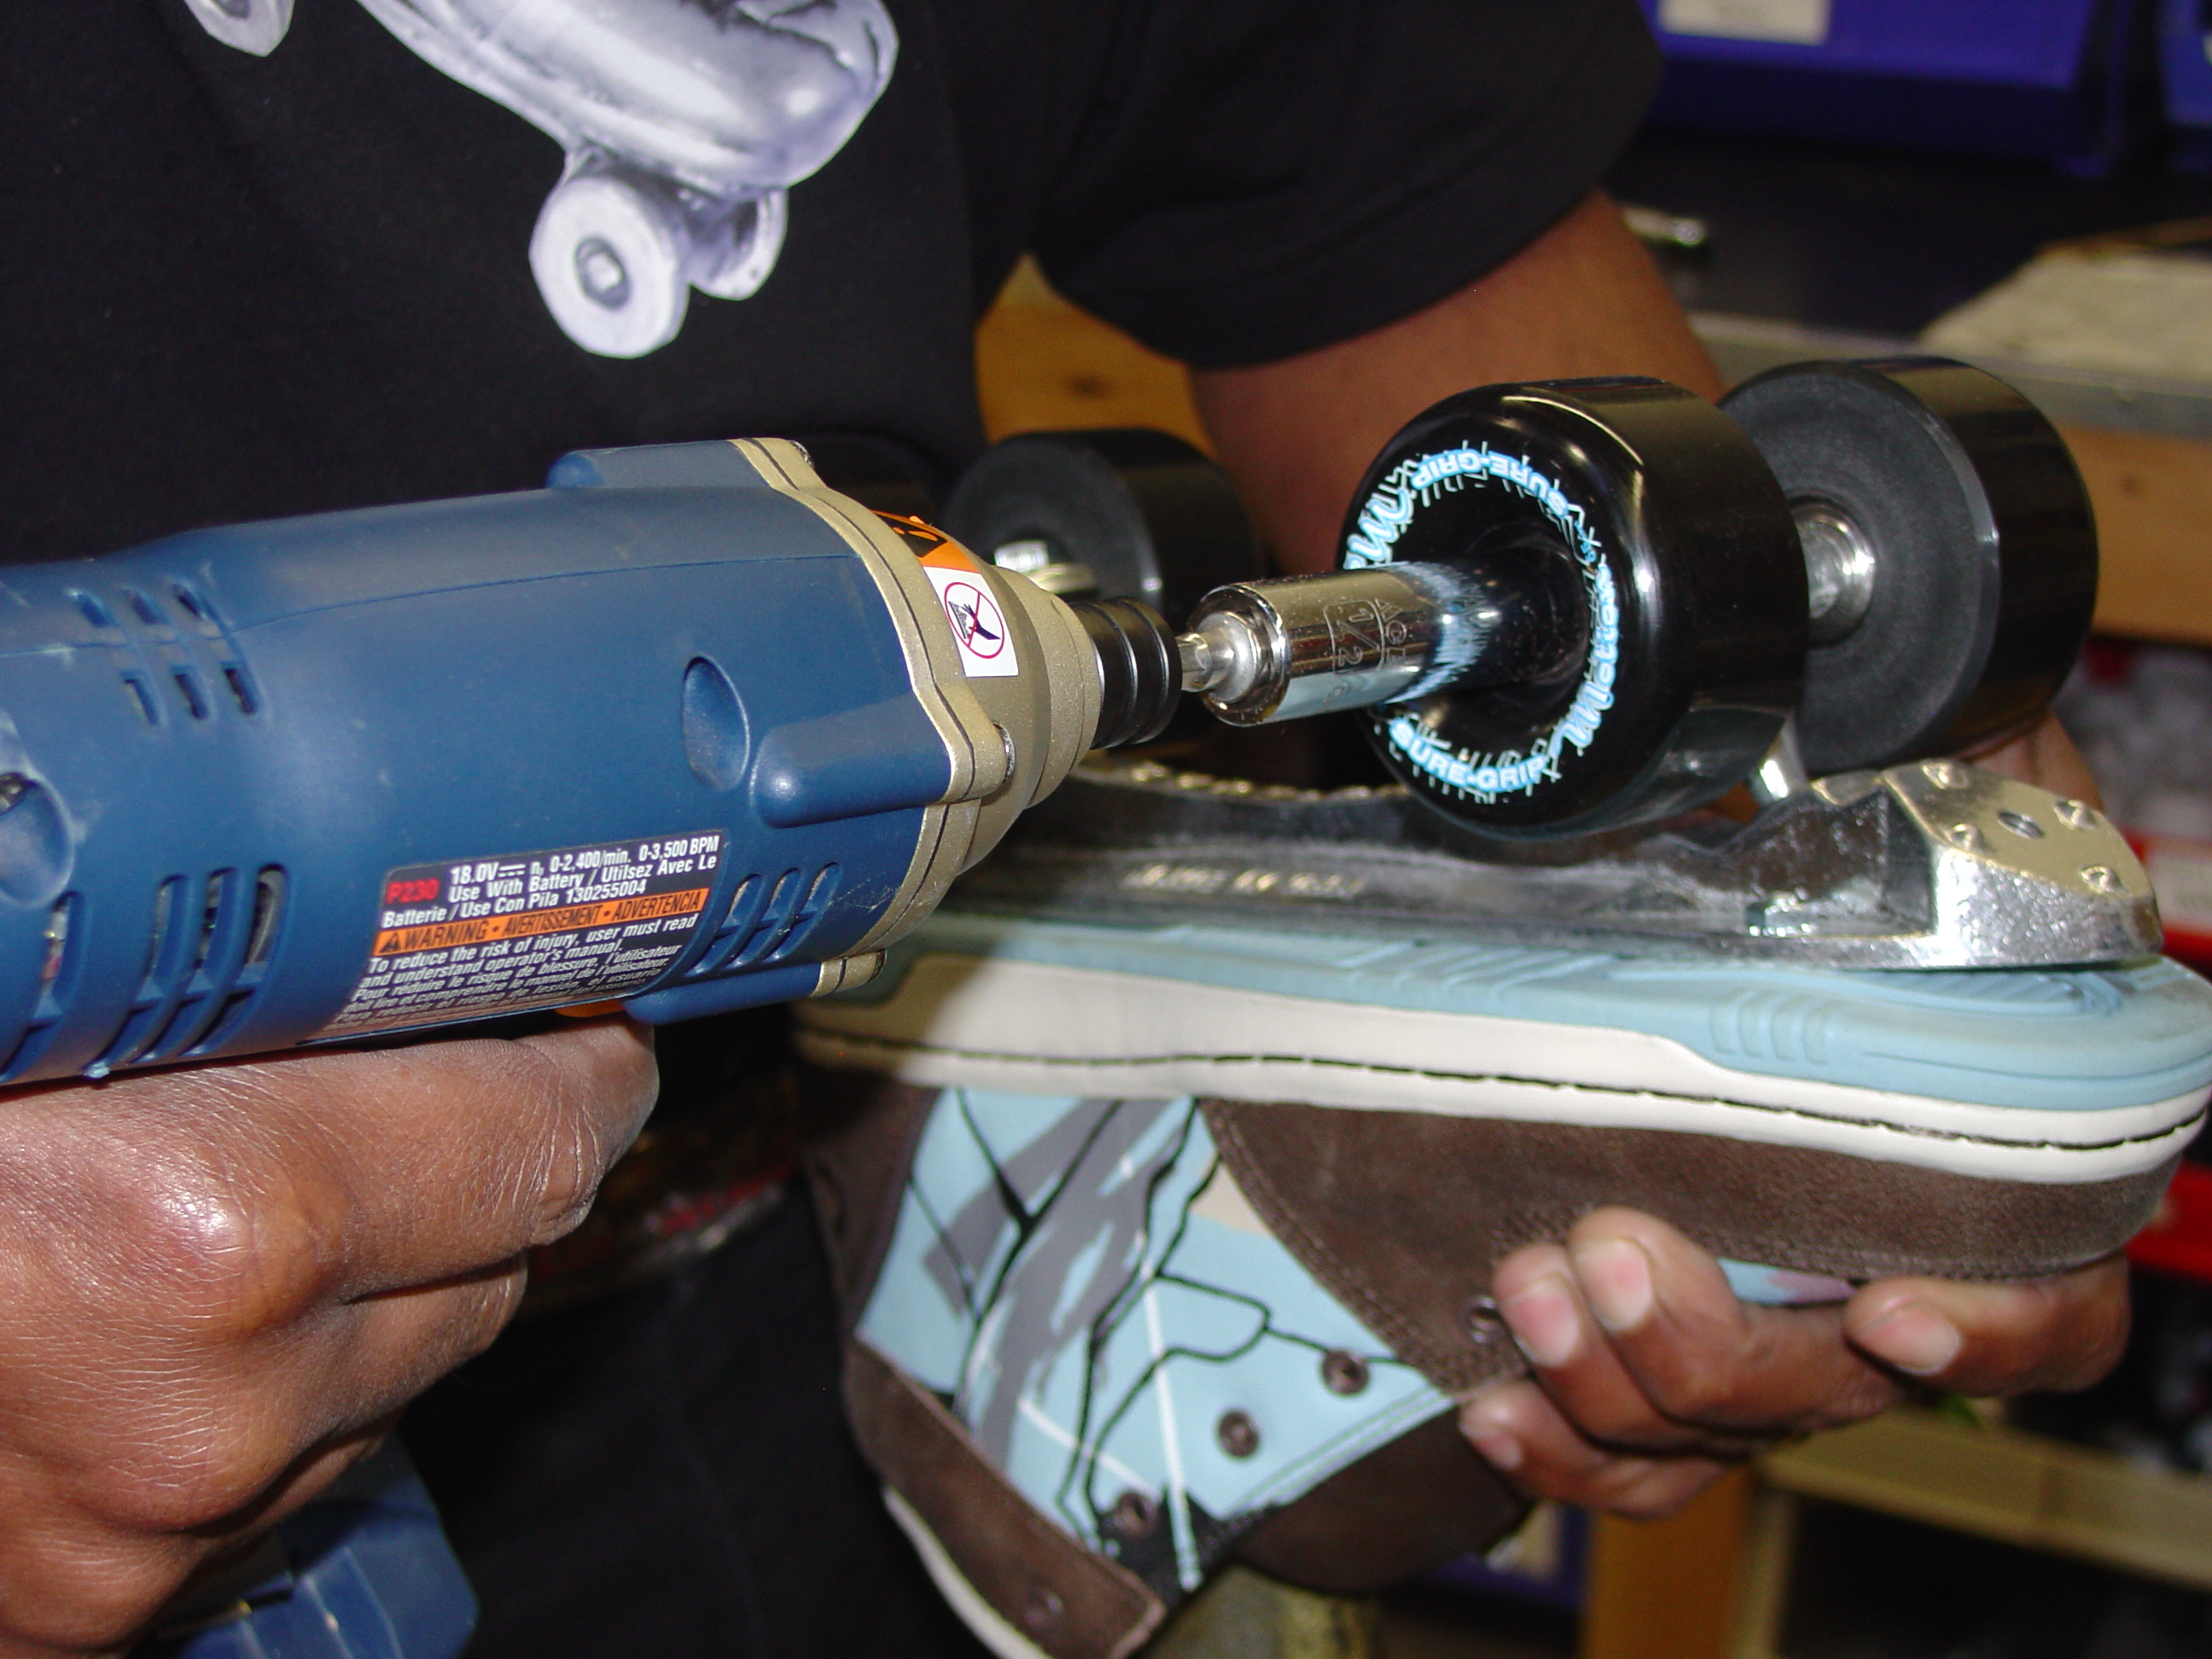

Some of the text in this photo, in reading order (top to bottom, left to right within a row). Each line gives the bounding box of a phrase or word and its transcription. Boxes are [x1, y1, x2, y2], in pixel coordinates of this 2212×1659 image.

[1411, 448, 1570, 518] SURE-GRIP
[1551, 564, 1619, 757] Motion
[1389, 717, 1549, 795] SURE-GRIP
[640, 841, 688, 862] 0-3,500
[690, 835, 719, 856] BPM
[387, 878, 439, 905] P230
[449, 886, 480, 903] Use
[487, 879, 522, 898] With
[529, 872, 584, 893] Battery
[658, 859, 692, 876] Avec
[699, 855, 717, 870] Le
[381, 907, 446, 929] Batterie
[460, 902, 491, 918] Use
[495, 897, 525, 914] Con
[528, 893, 559, 909] Pila
[567, 880, 646, 904] 130255004
[404, 892, 701, 950] WARNING AVERTISSEMENT ADVERTENCIA
[360, 940, 622, 988] and understand operator's manual.
[370, 913, 698, 974] To reduce the risk of injury, user must read
[352, 988, 389, 1002] Pour
[450, 976, 465, 988] le
[468, 970, 513, 989] risque
[516, 964, 536, 978] de
[416, 982, 507, 1004] comprendre
